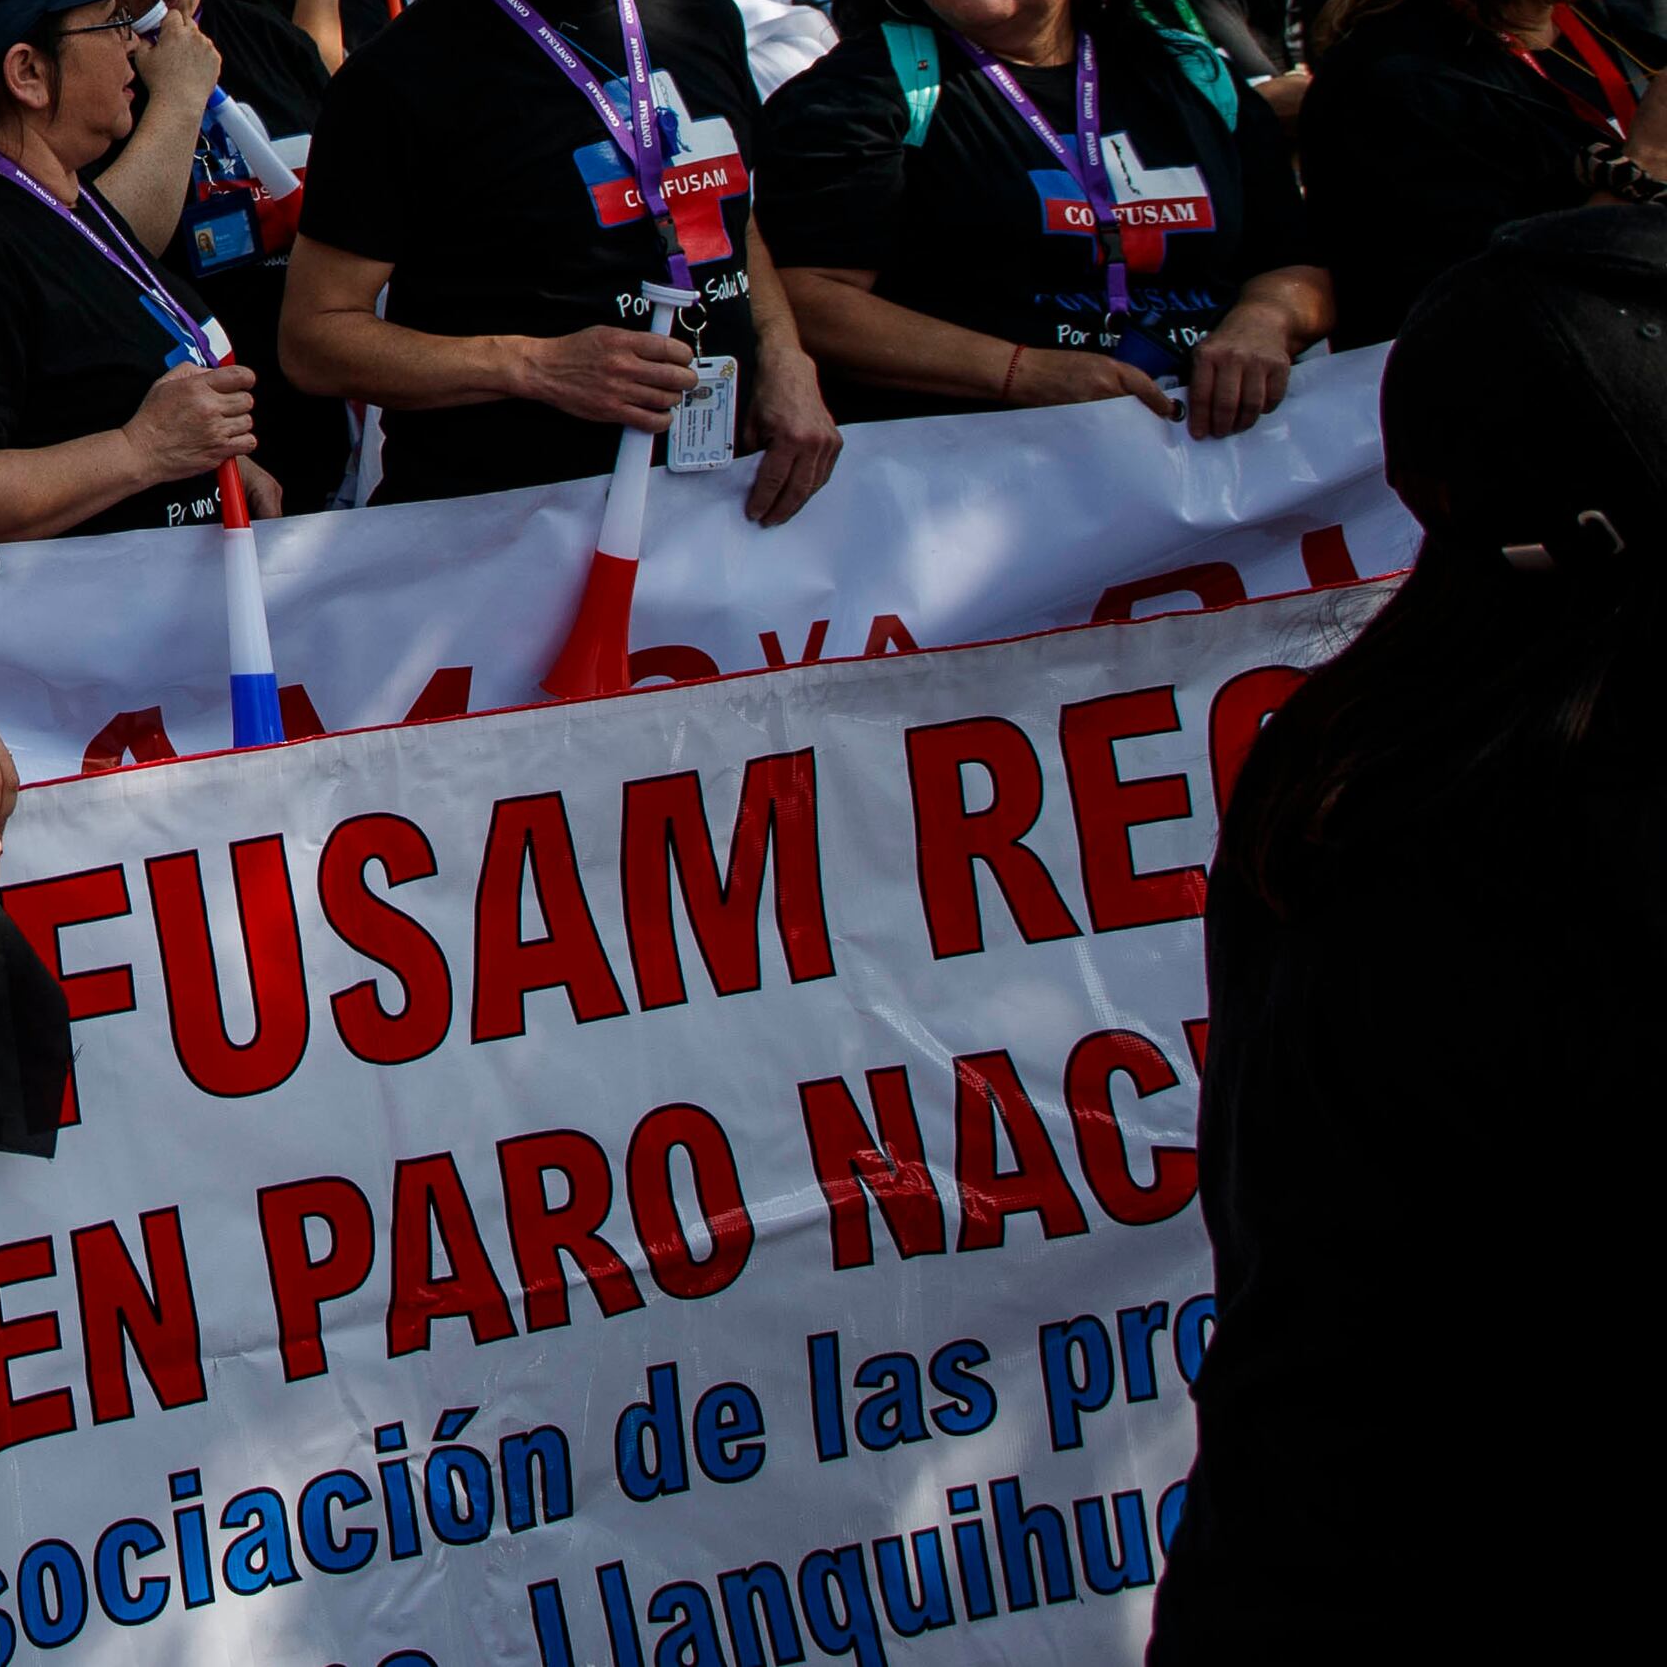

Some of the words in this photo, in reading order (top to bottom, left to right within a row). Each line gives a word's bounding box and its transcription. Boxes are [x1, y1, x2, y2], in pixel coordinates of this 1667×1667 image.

[537, 26, 578, 69] CONFUSAM
[629, 37, 646, 84] CONFUSAM
[585, 80, 621, 128] CONFUSAM
[638, 99, 654, 149] CONFUSAM
[1064, 202, 1198, 229] COFUSAM
[1056, 323, 1088, 346] Por
[256, 1102, 755, 1384] PARO
[799, 1018, 1208, 1270] NAC
[614, 1362, 767, 1503] de
[807, 1330, 999, 1462] las
